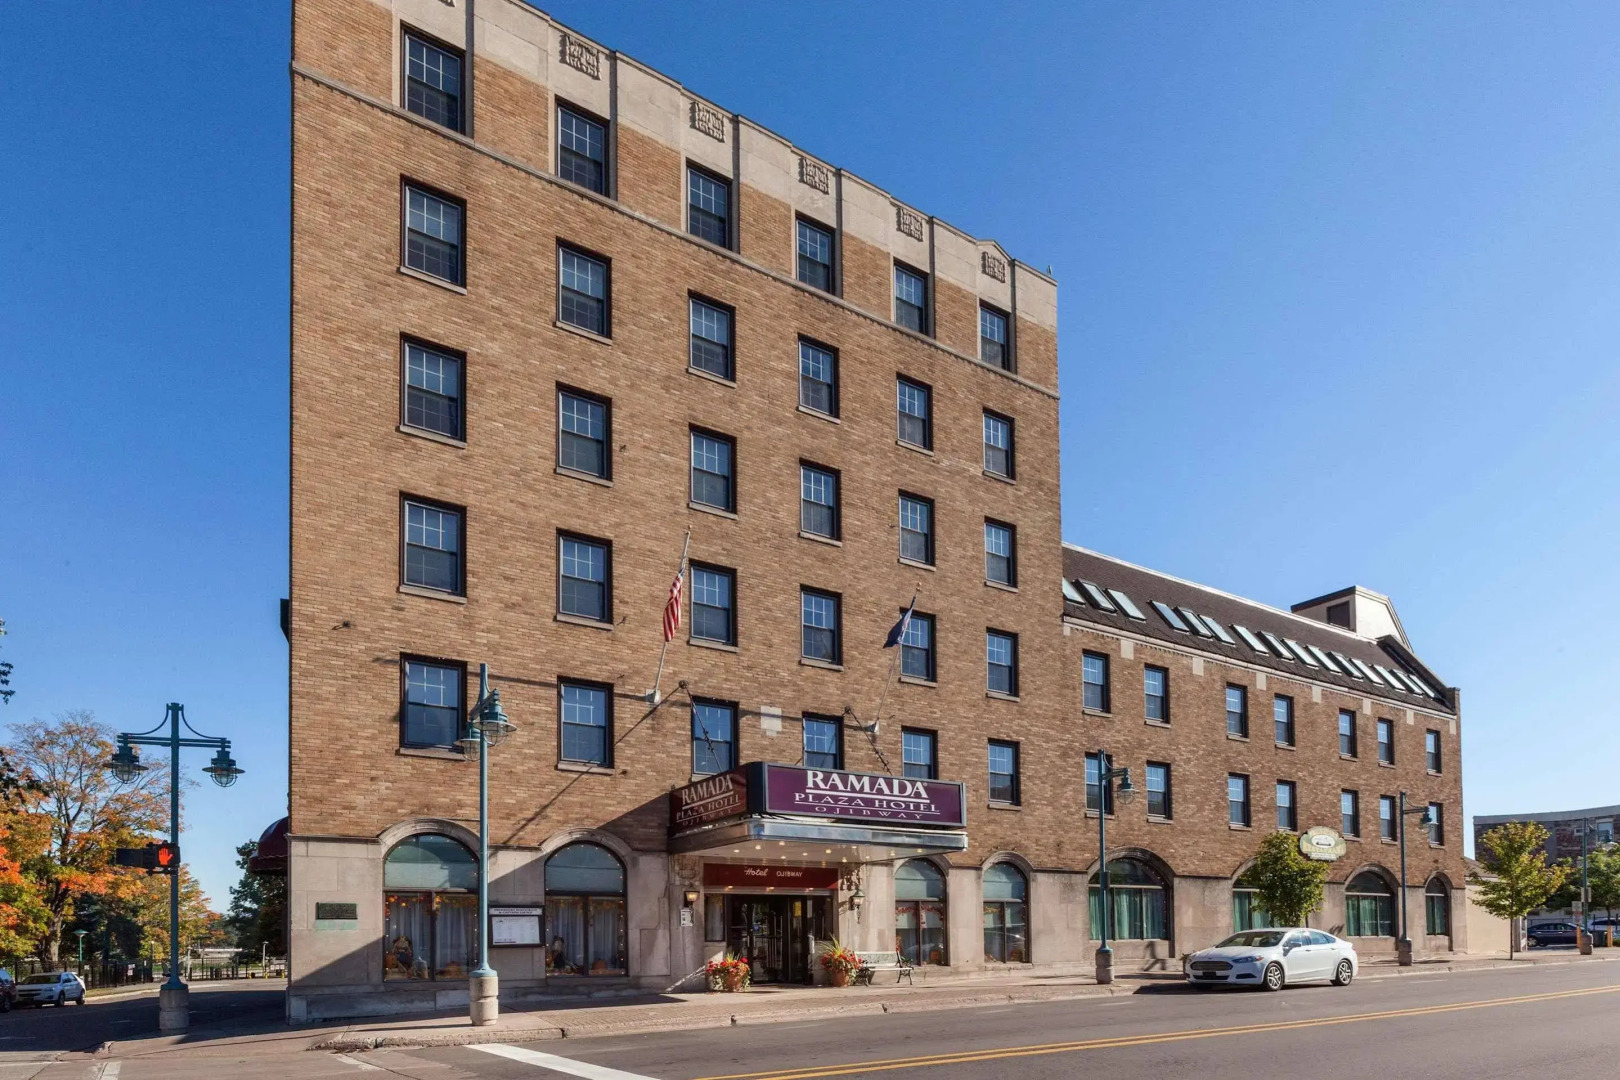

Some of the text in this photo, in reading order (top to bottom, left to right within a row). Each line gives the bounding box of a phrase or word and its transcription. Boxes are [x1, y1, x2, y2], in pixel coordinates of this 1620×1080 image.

[681, 774, 733, 805] RAMADA
[806, 770, 929, 798] RAMADA
[676, 794, 740, 820] PLAZA HOTEL
[794, 793, 940, 812] PLAZA HOTEL
[682, 809, 732, 826] OJIBWAY
[815, 806, 923, 819] OJIBWAY
[744, 868, 769, 876] Hotel
